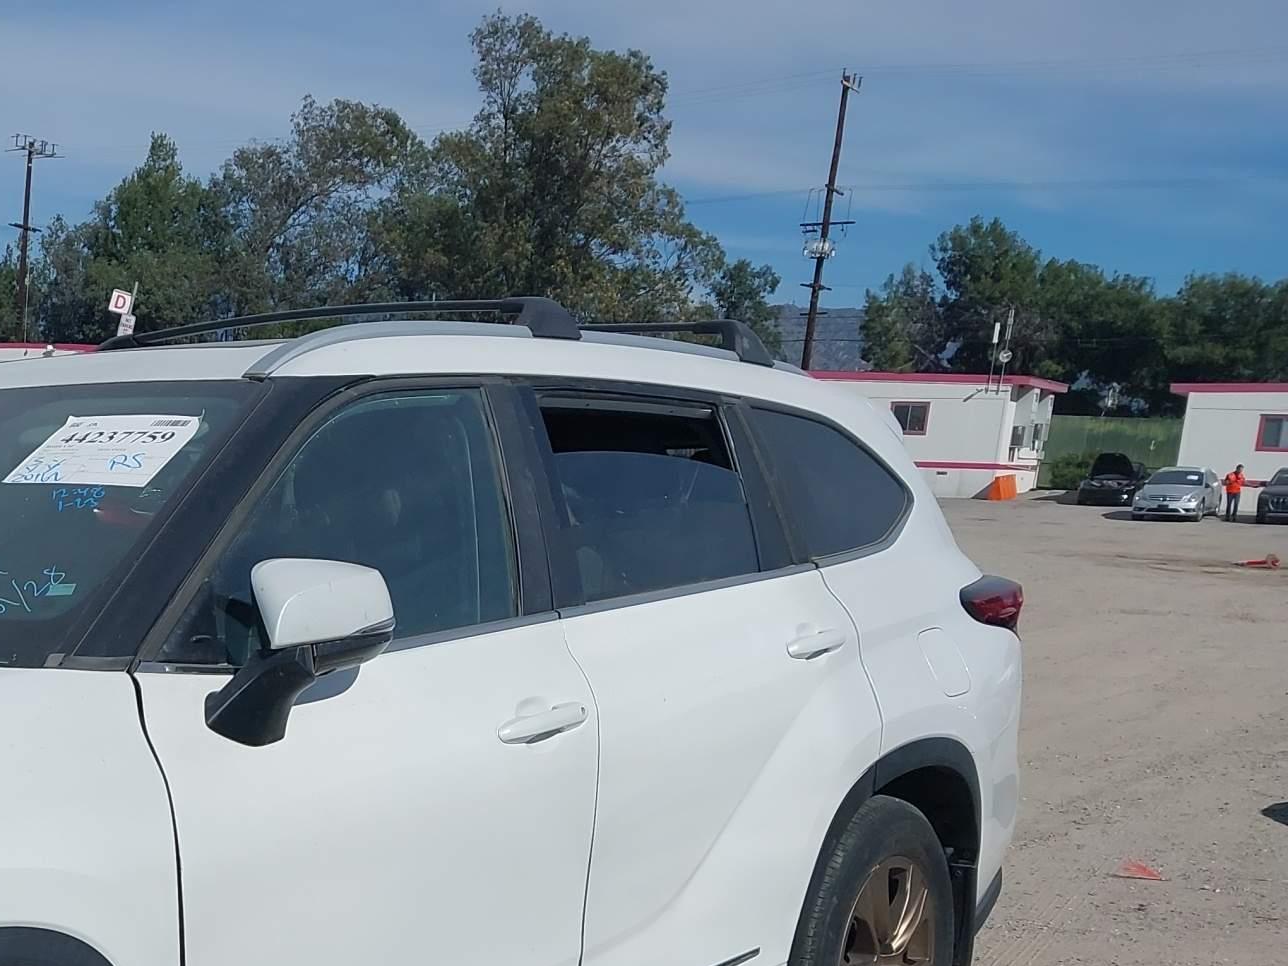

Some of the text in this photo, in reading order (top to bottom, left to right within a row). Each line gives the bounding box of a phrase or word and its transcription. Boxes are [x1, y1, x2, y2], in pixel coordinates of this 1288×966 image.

[114, 294, 127, 309] D
[60, 431, 176, 444] 44237759
[109, 452, 146, 471] RS
